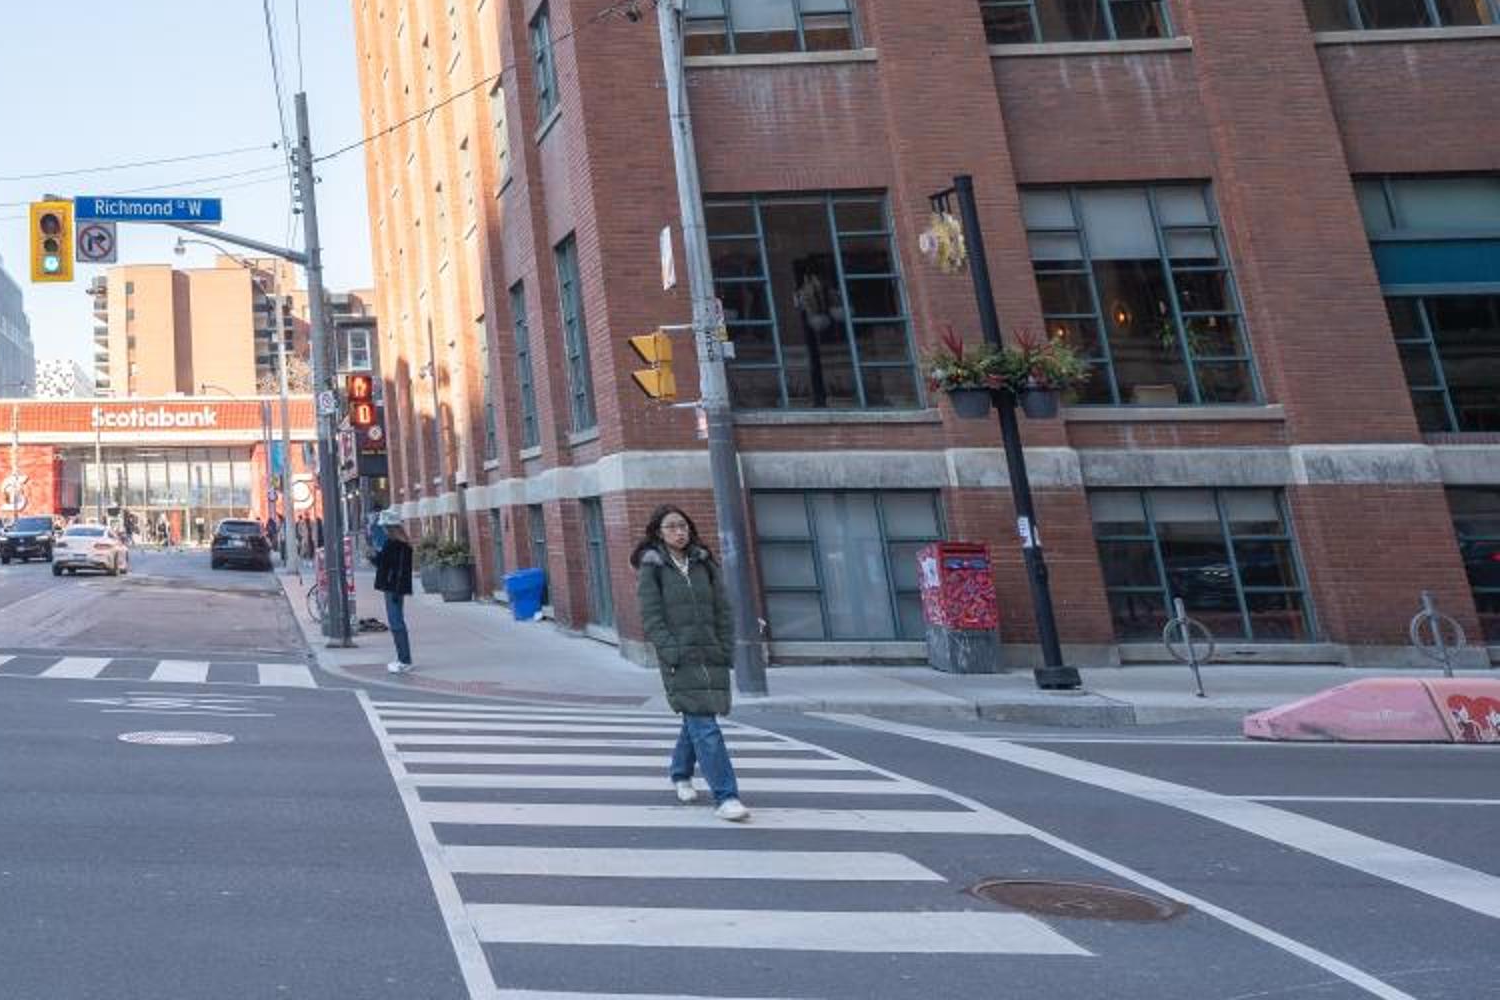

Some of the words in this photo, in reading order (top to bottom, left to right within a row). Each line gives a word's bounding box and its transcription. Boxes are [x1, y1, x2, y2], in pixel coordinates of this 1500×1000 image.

[95, 199, 173, 216] Richmond
[188, 199, 202, 216] W
[91, 405, 218, 428] Scotiabank
